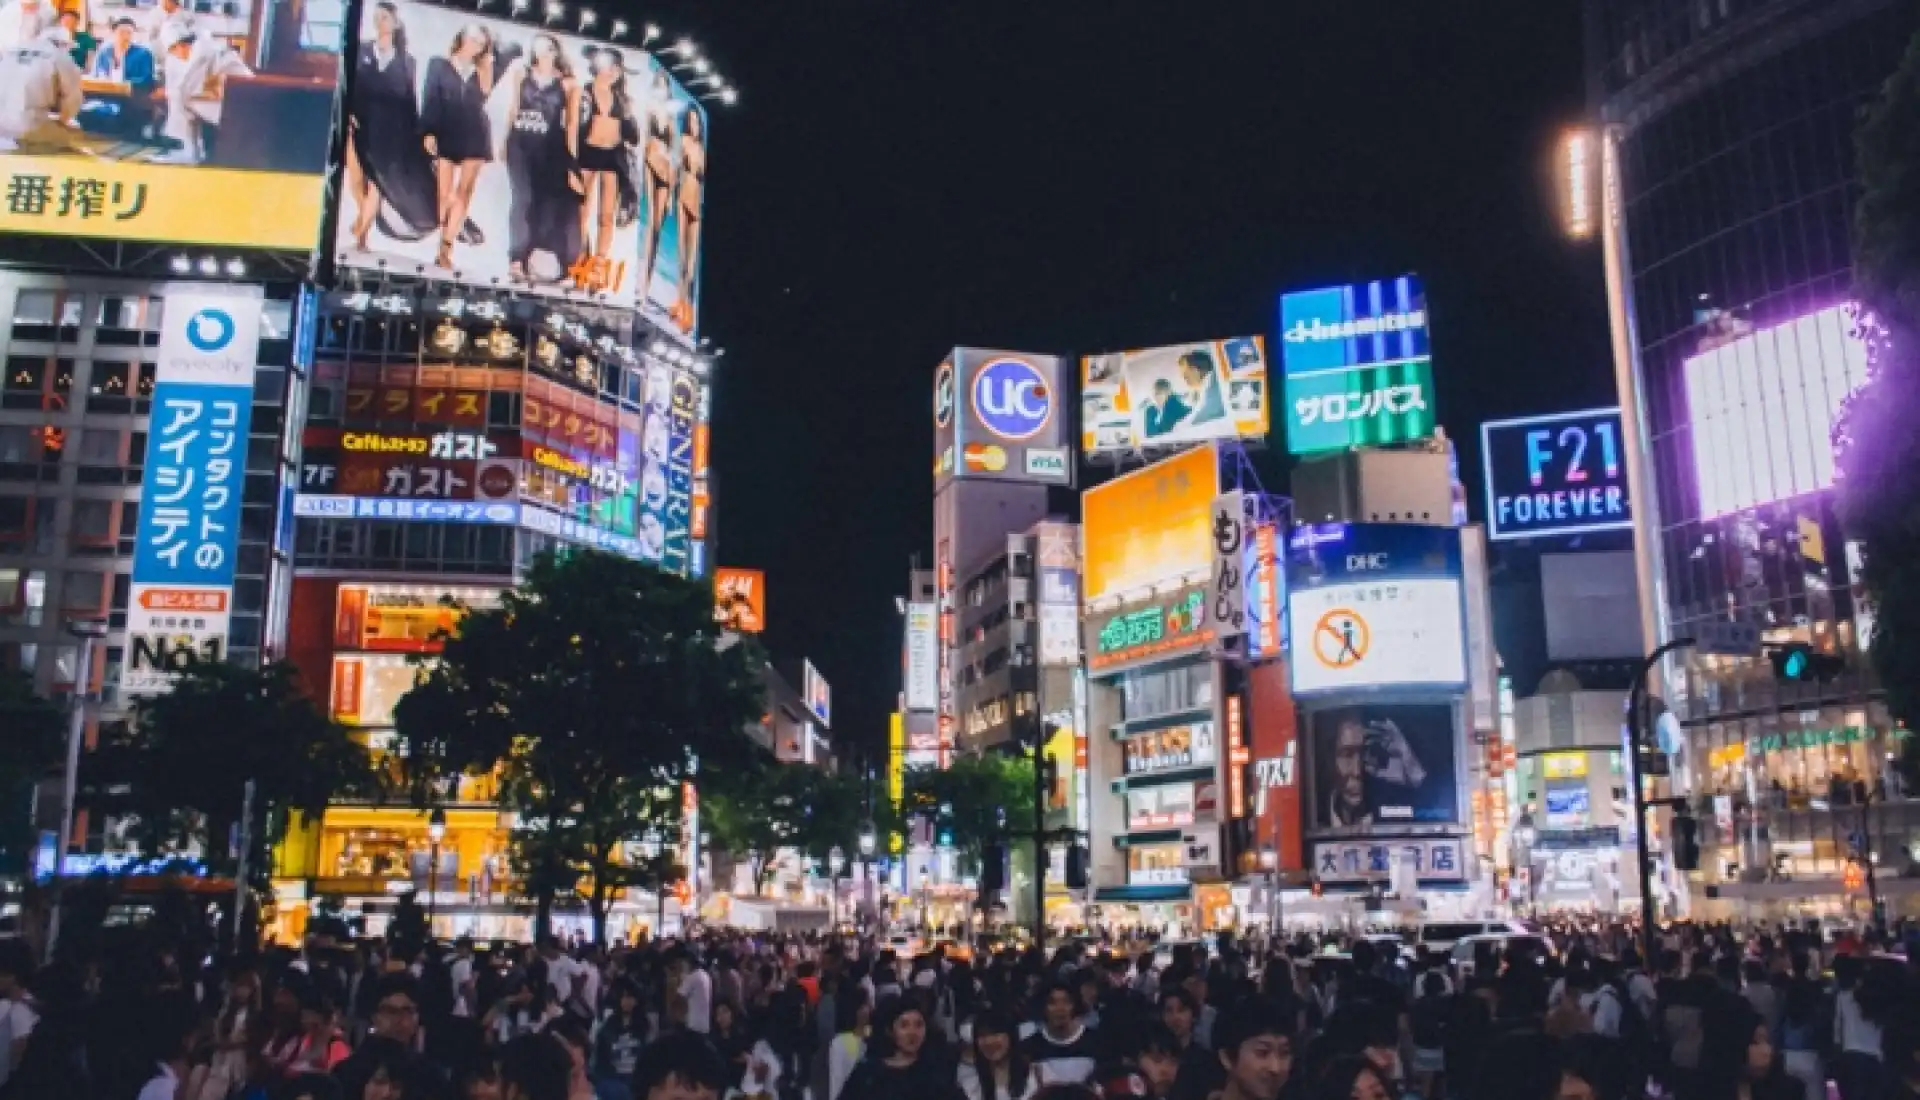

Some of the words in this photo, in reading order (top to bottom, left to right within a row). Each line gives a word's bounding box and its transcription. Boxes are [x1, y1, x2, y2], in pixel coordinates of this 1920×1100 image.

[7, 174, 148, 220] 番搾り
[981, 375, 1047, 419] UC
[1295, 383, 1427, 426] サロンパス
[428, 431, 498, 460] ガスト
[1526, 422, 1618, 487] F21
[151, 399, 204, 568] アイシティ
[194, 401, 239, 570] コンタクトの
[303, 464, 337, 485] 7F
[383, 462, 468, 496] ガスト
[1498, 485, 1623, 525] FOREVER
[1346, 552, 1388, 572] DHC
